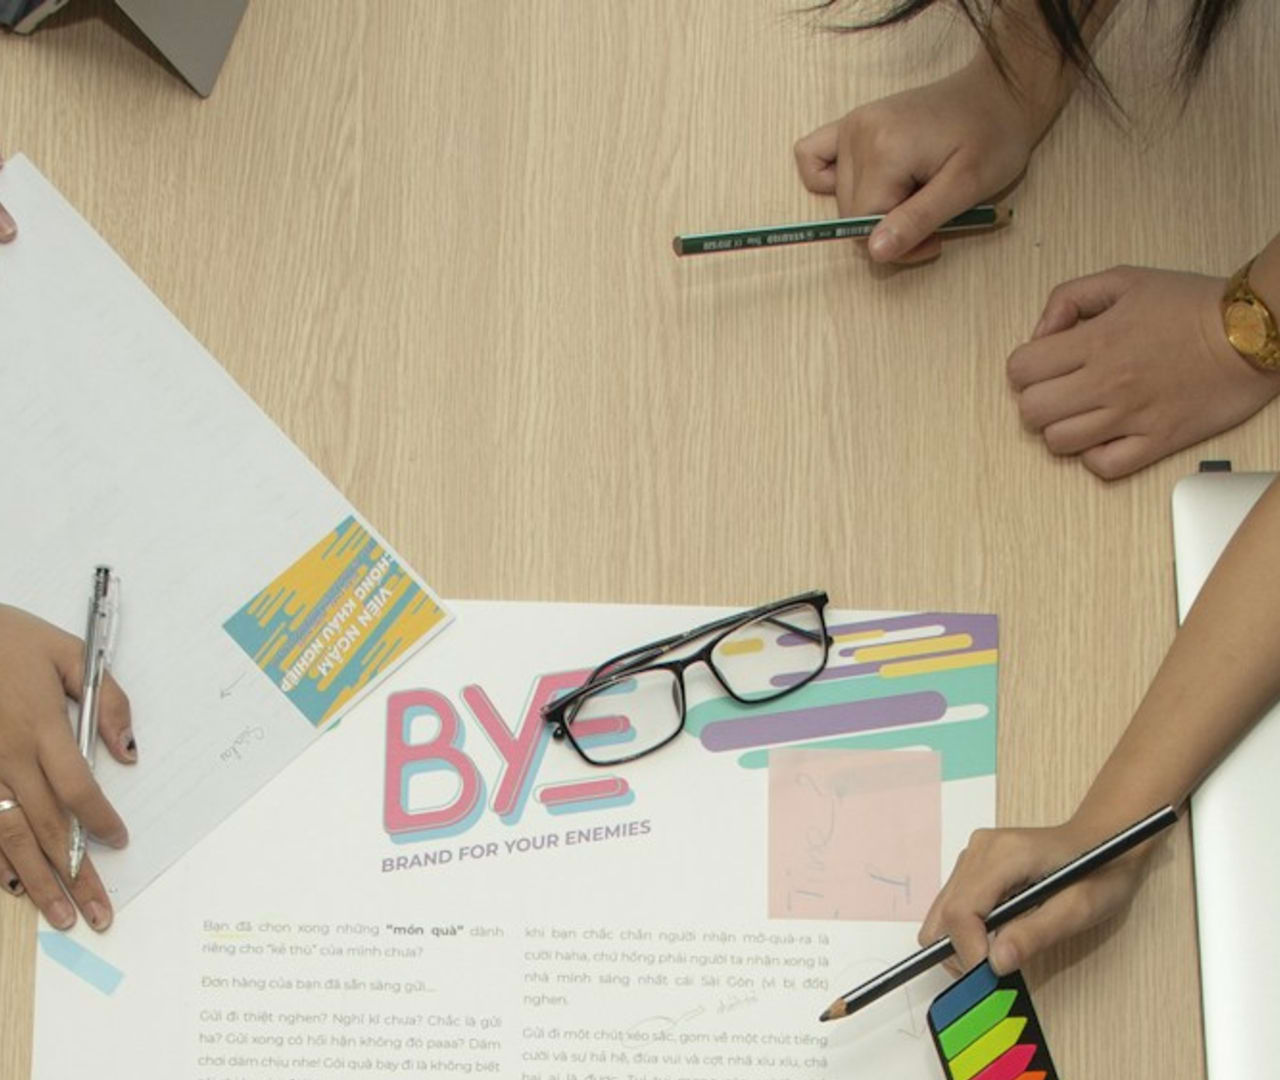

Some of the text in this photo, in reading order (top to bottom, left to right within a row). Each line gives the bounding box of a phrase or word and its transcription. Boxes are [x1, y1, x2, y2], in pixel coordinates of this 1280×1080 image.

[383, 664, 637, 845] BYE
[381, 820, 652, 873] BRAND FOR YOUR ENEMIES
[384, 922, 424, 935] "món
[430, 923, 464, 940] quà"
